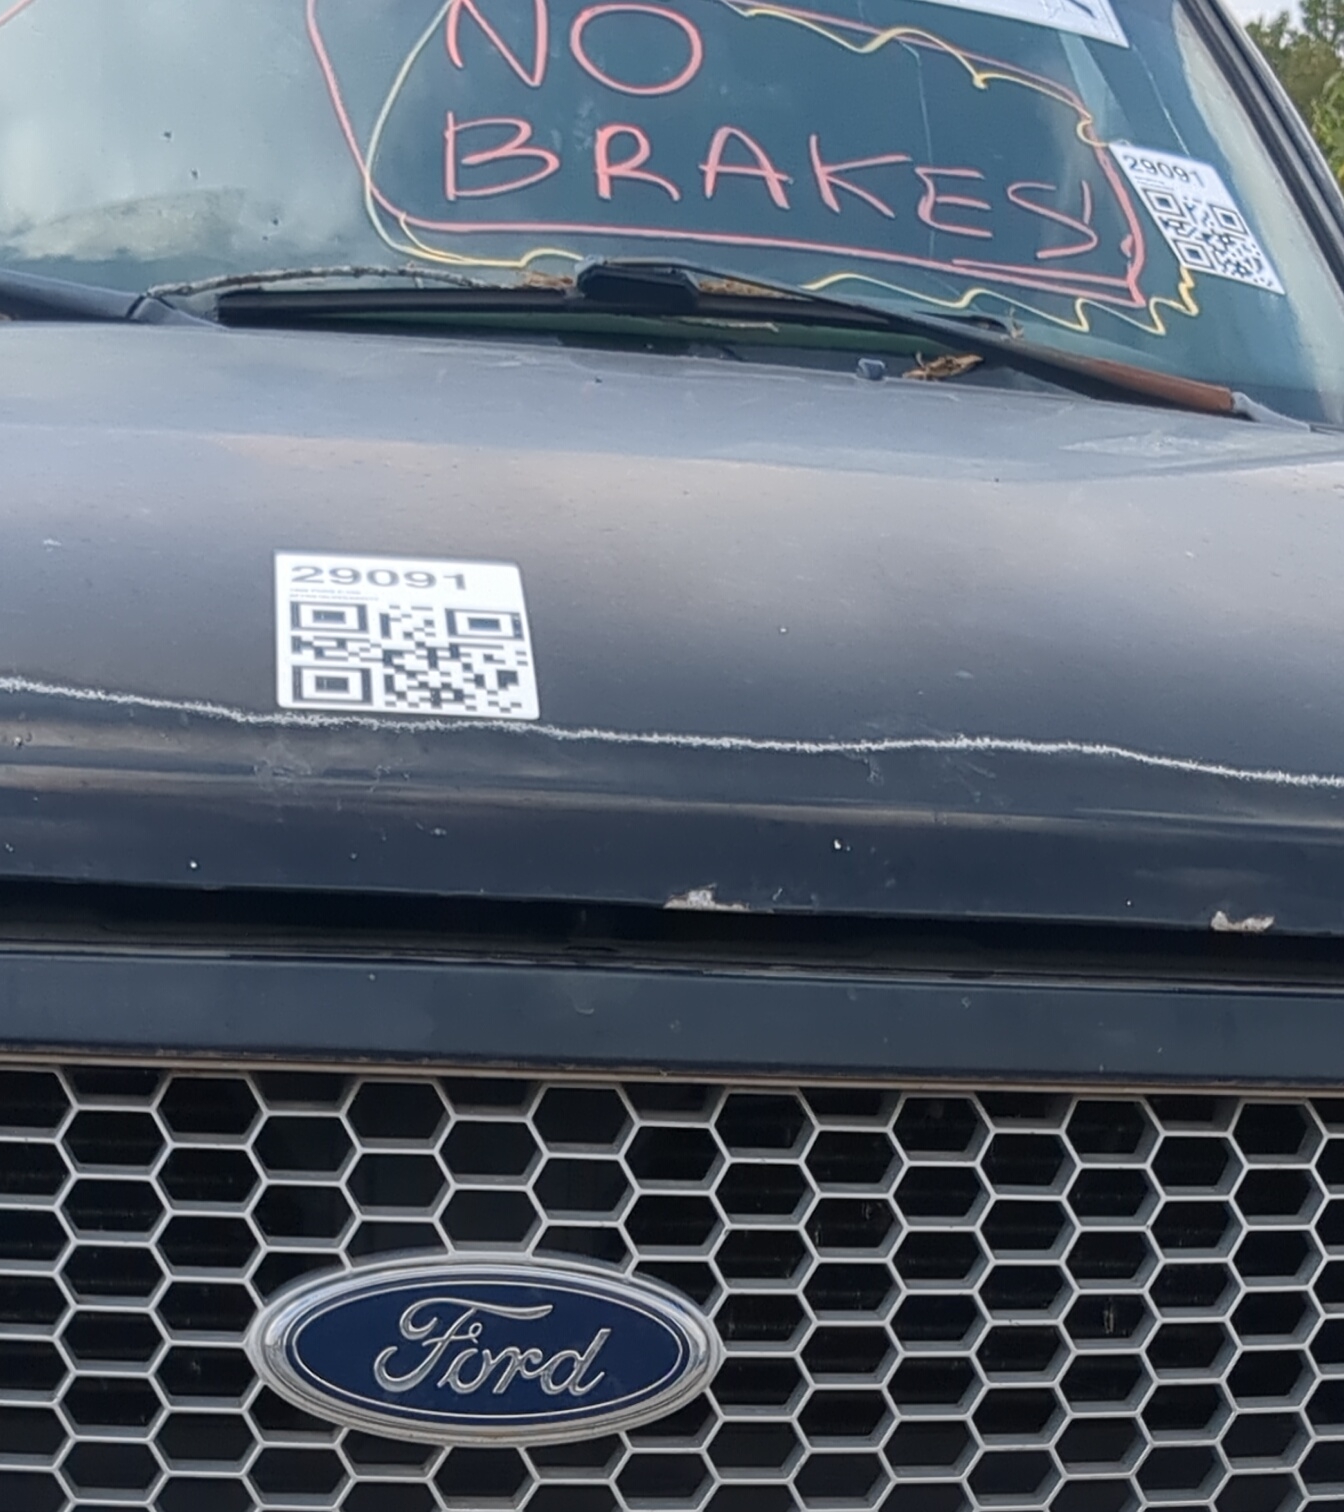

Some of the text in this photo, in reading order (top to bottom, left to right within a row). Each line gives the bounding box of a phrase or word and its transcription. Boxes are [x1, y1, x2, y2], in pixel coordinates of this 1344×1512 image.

[446, 0, 704, 96] NO
[1122, 155, 1205, 188] 29091
[290, 565, 467, 591] 29091
[373, 1297, 611, 1396] Ford
